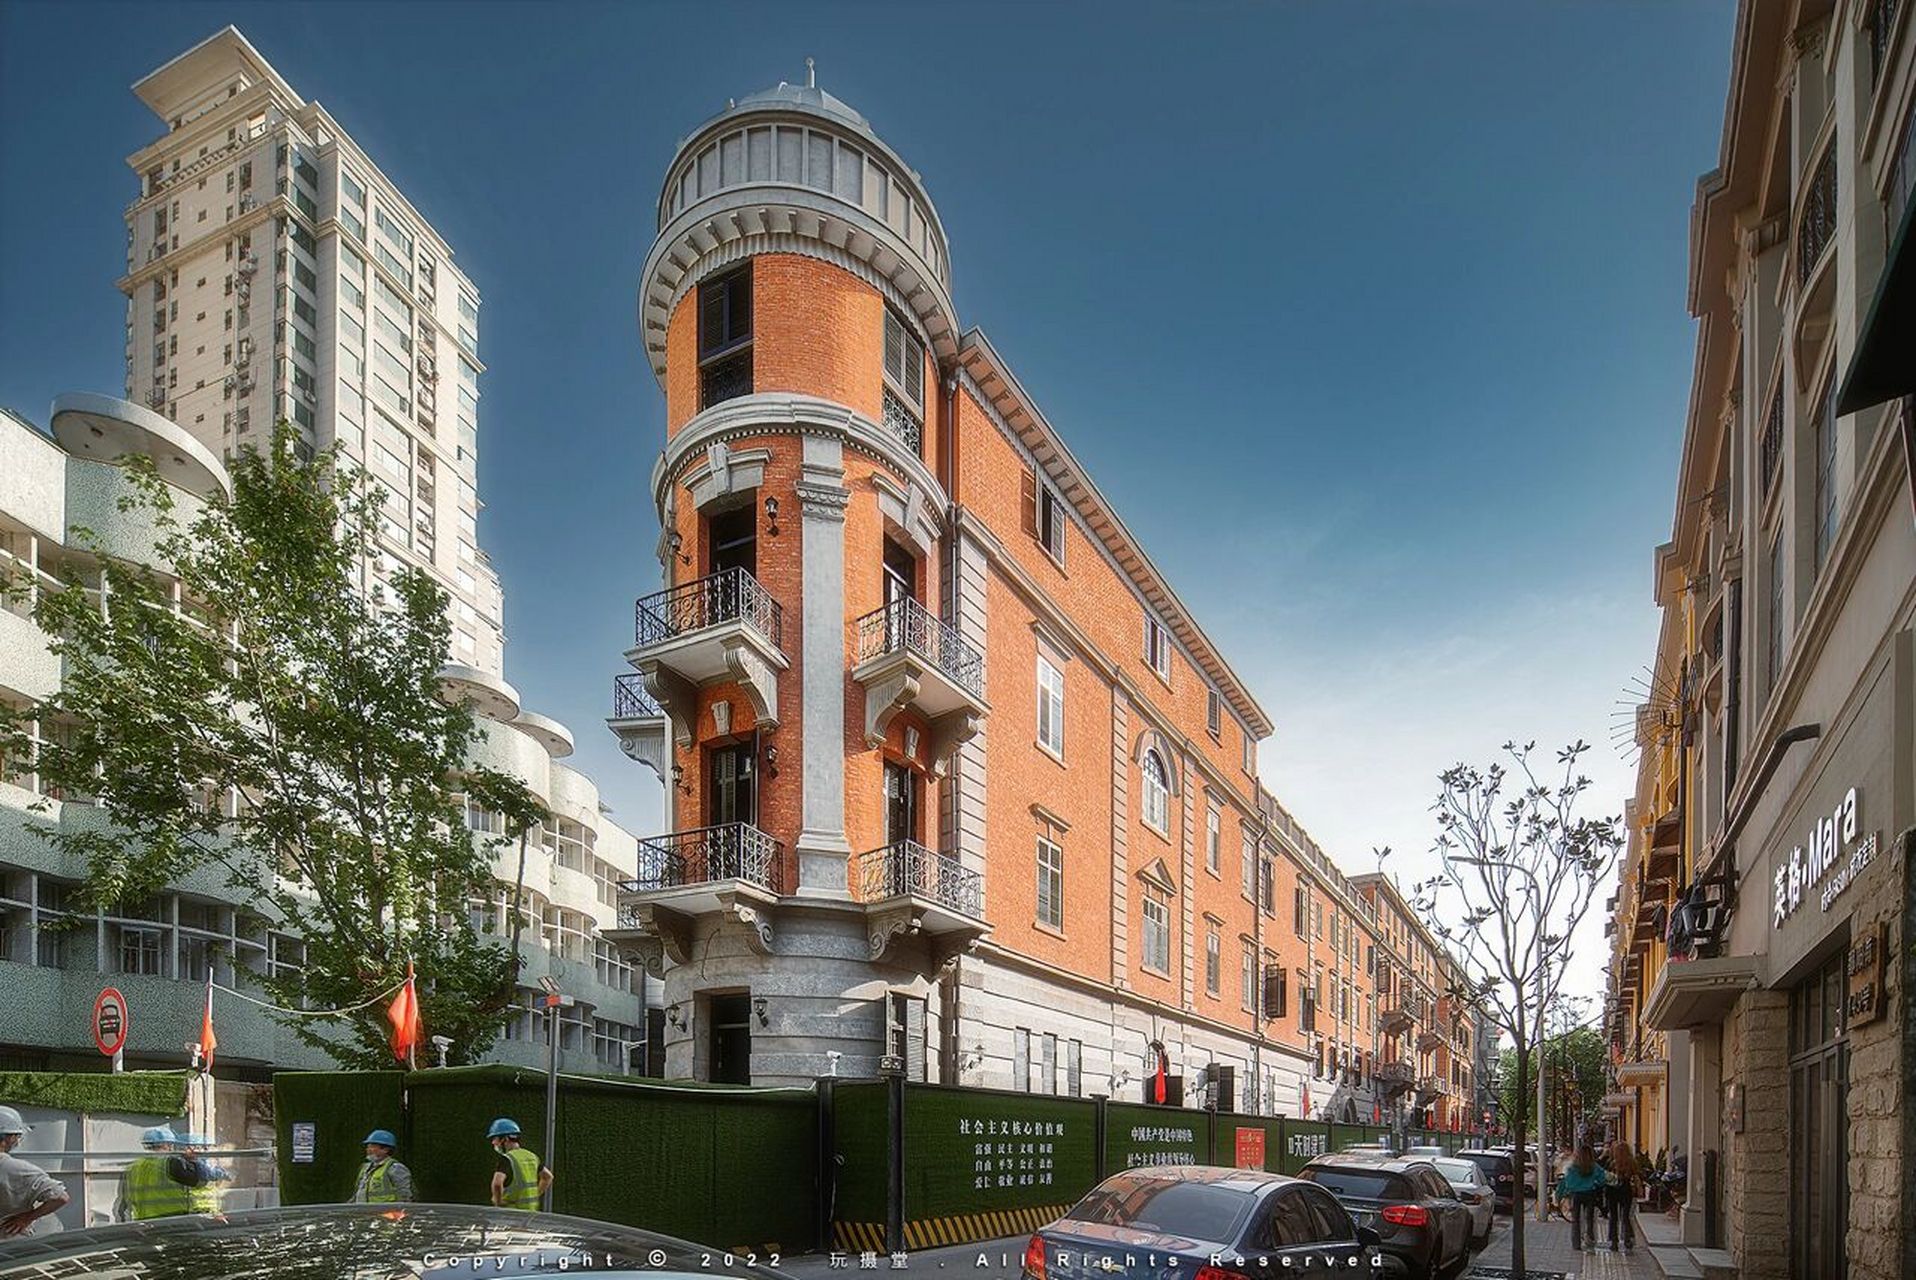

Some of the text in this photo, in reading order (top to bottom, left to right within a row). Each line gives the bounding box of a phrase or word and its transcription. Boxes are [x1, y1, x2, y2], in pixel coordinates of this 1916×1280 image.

[959, 1118, 1064, 1136] 社会主义核心价值观
[975, 1159, 992, 1171] 自由
